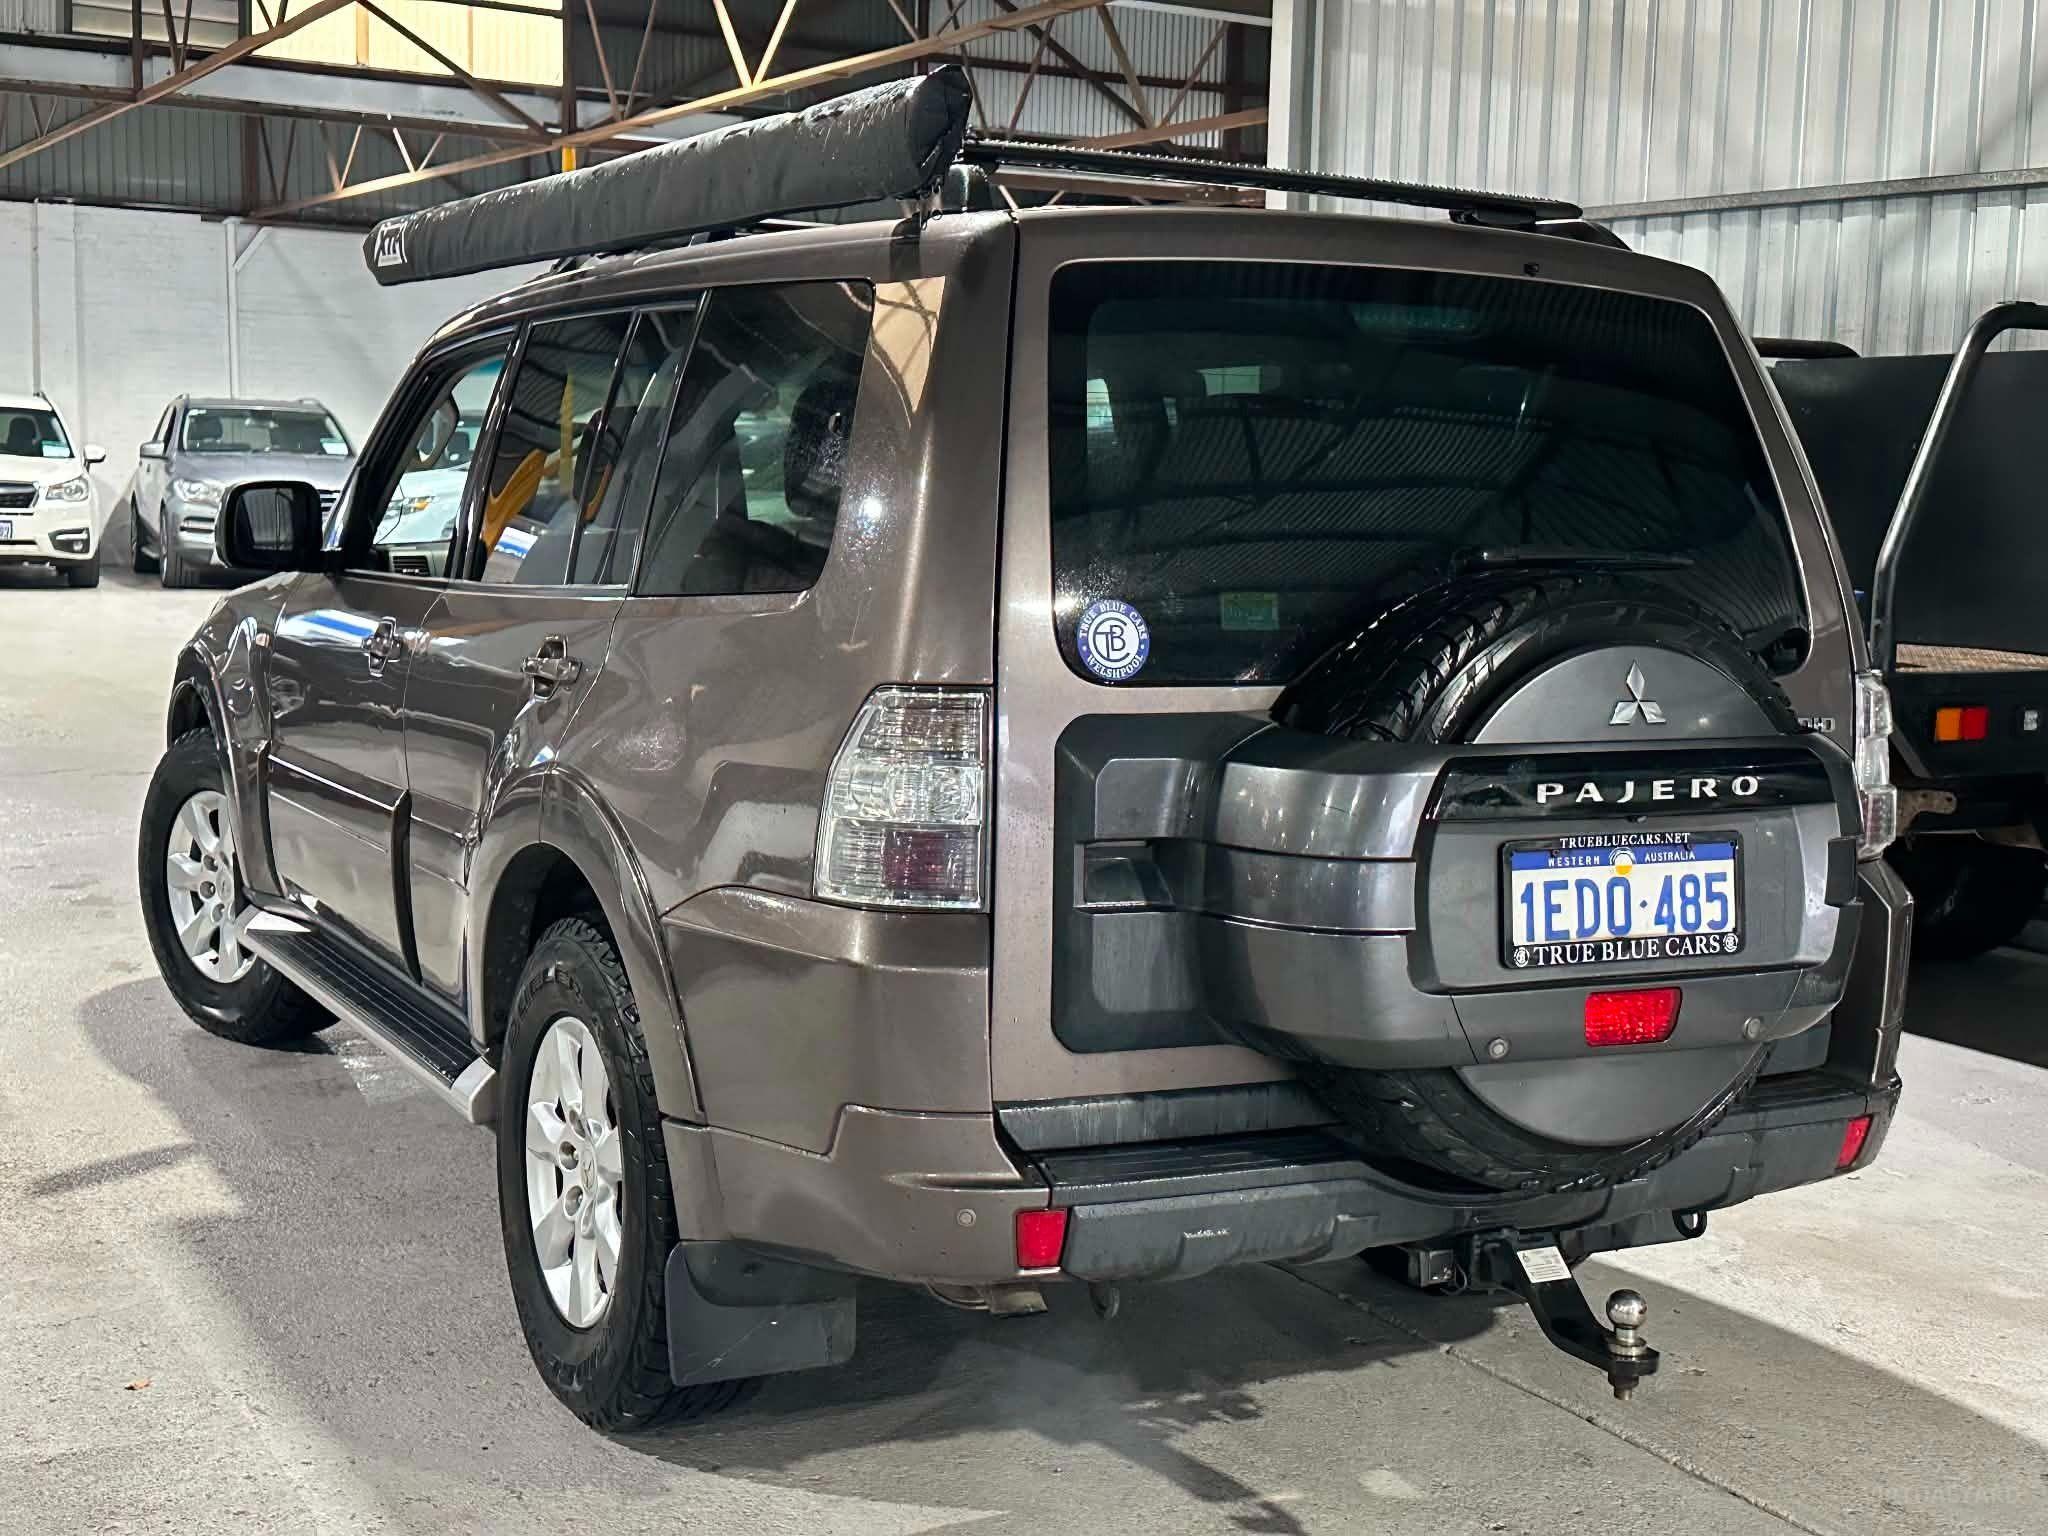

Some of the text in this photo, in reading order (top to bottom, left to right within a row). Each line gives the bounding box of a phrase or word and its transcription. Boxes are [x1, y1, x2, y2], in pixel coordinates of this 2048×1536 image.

[1080, 601, 1148, 640] TRUE BLUE CARS
[1087, 654, 1144, 679] WELSHPOOL
[1536, 775, 1759, 804] PAJERO
[1560, 832, 1691, 849] TRUEBLUECARS.NET
[1548, 850, 1695, 867] WESTERN AUSTRALIA
[1533, 943, 1596, 966] TRUE
[1602, 938, 1660, 961] BLUE
[1665, 934, 1720, 957] CARS
